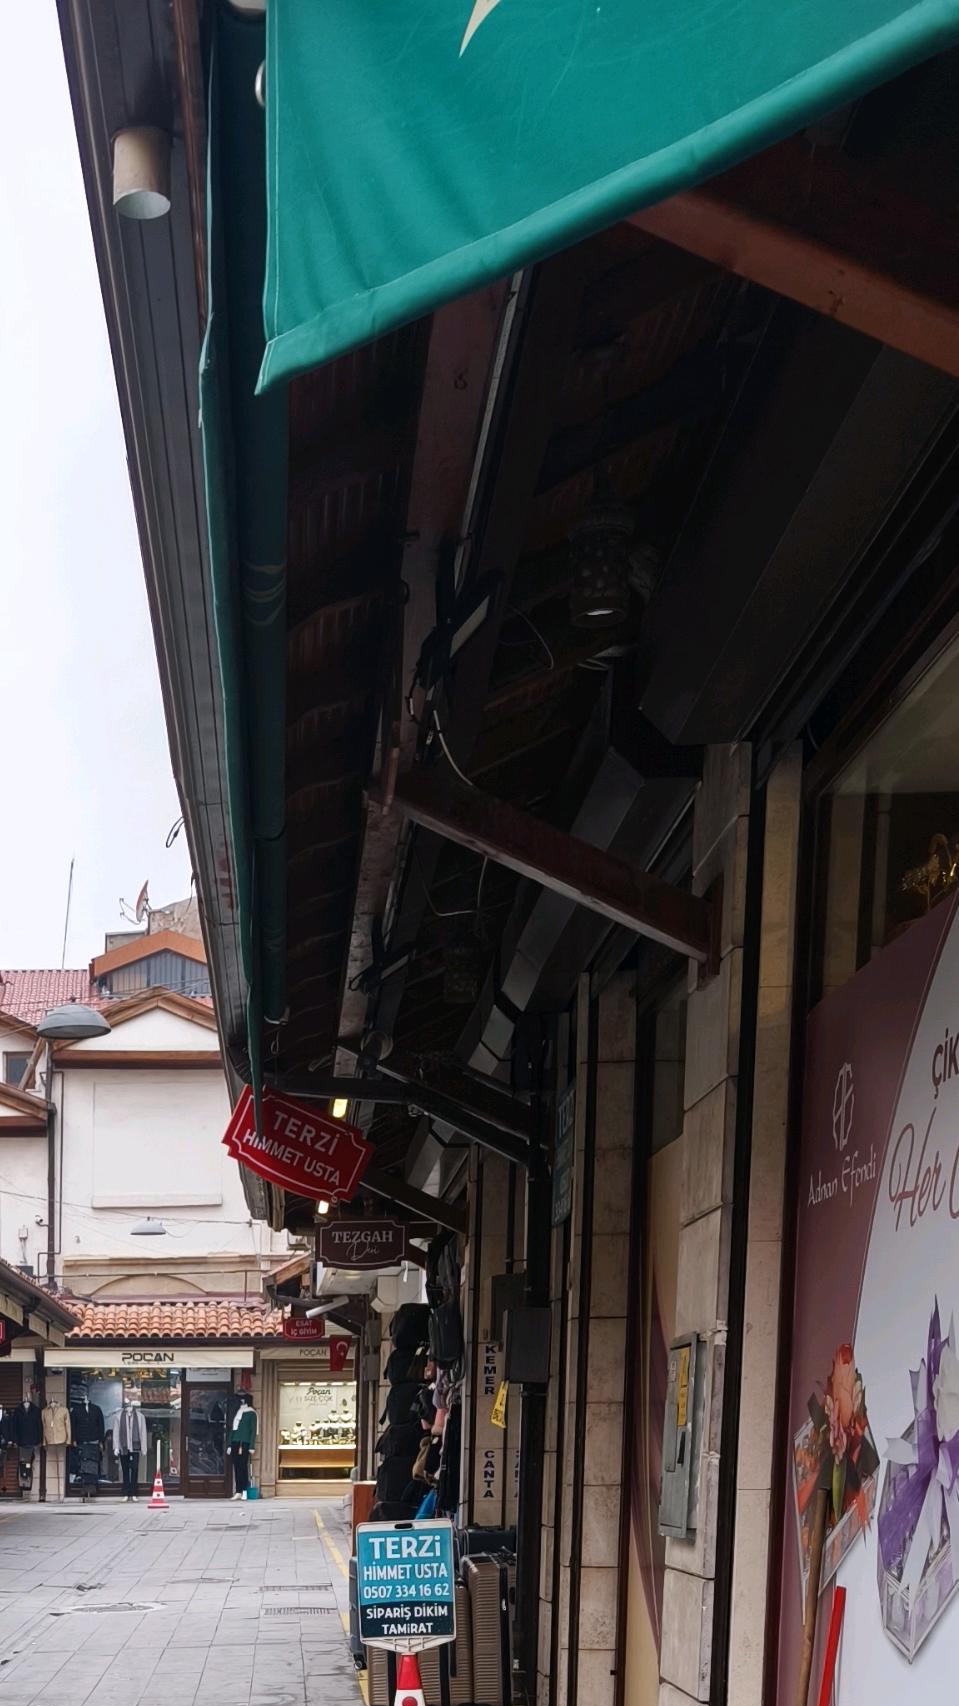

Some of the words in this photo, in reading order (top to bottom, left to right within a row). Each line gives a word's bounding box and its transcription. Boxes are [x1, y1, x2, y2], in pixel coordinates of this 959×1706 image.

[274, 1111, 340, 1156] TERZİ
[304, 1157, 341, 1185] USTA
[807, 1170, 838, 1209] Adnan
[841, 1143, 877, 1209] Efendi
[889, 1106, 946, 1232] Her
[331, 1230, 393, 1243] TEZGAH
[484, 1345, 497, 1395] KEMER
[363, 1561, 412, 1581] HİMMET
[414, 1562, 448, 1579] USTA
[363, 1585, 392, 1599] 0507
[395, 1585, 416, 1598] 334
[419, 1584, 431, 1597] 16
[434, 1583, 449, 1596] 62
[366, 1603, 411, 1621] SİPARİŞ
[414, 1602, 448, 1618] DİKİM
